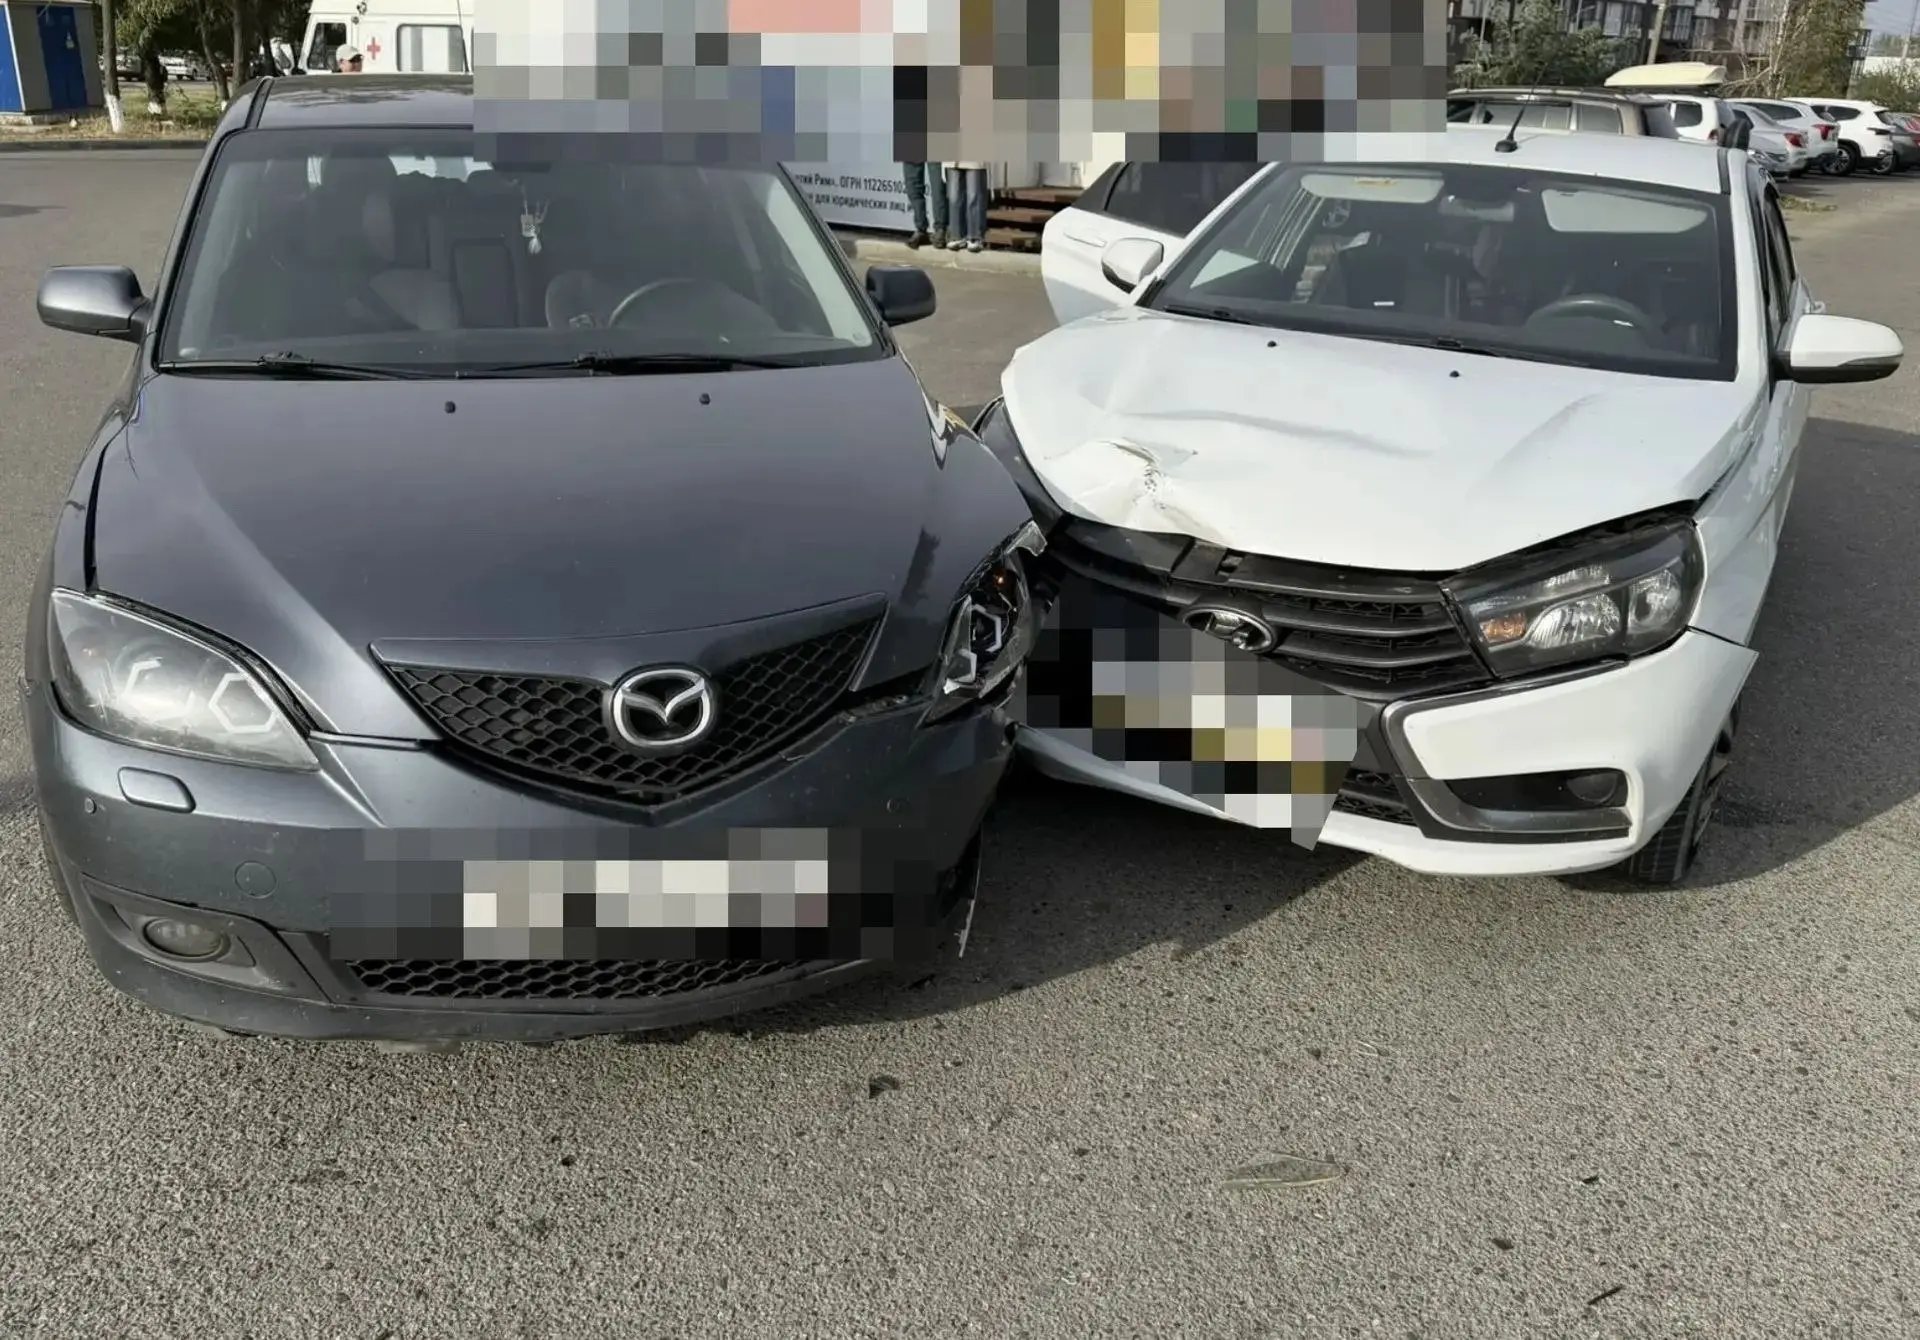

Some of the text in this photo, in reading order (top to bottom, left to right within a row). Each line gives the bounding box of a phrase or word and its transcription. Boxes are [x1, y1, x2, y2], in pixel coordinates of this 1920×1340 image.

[840, 176, 862, 190] ОГРН
[815, 193, 832, 204] для
[832, 195, 888, 210] юридических
[889, 201, 906, 213] лиц
